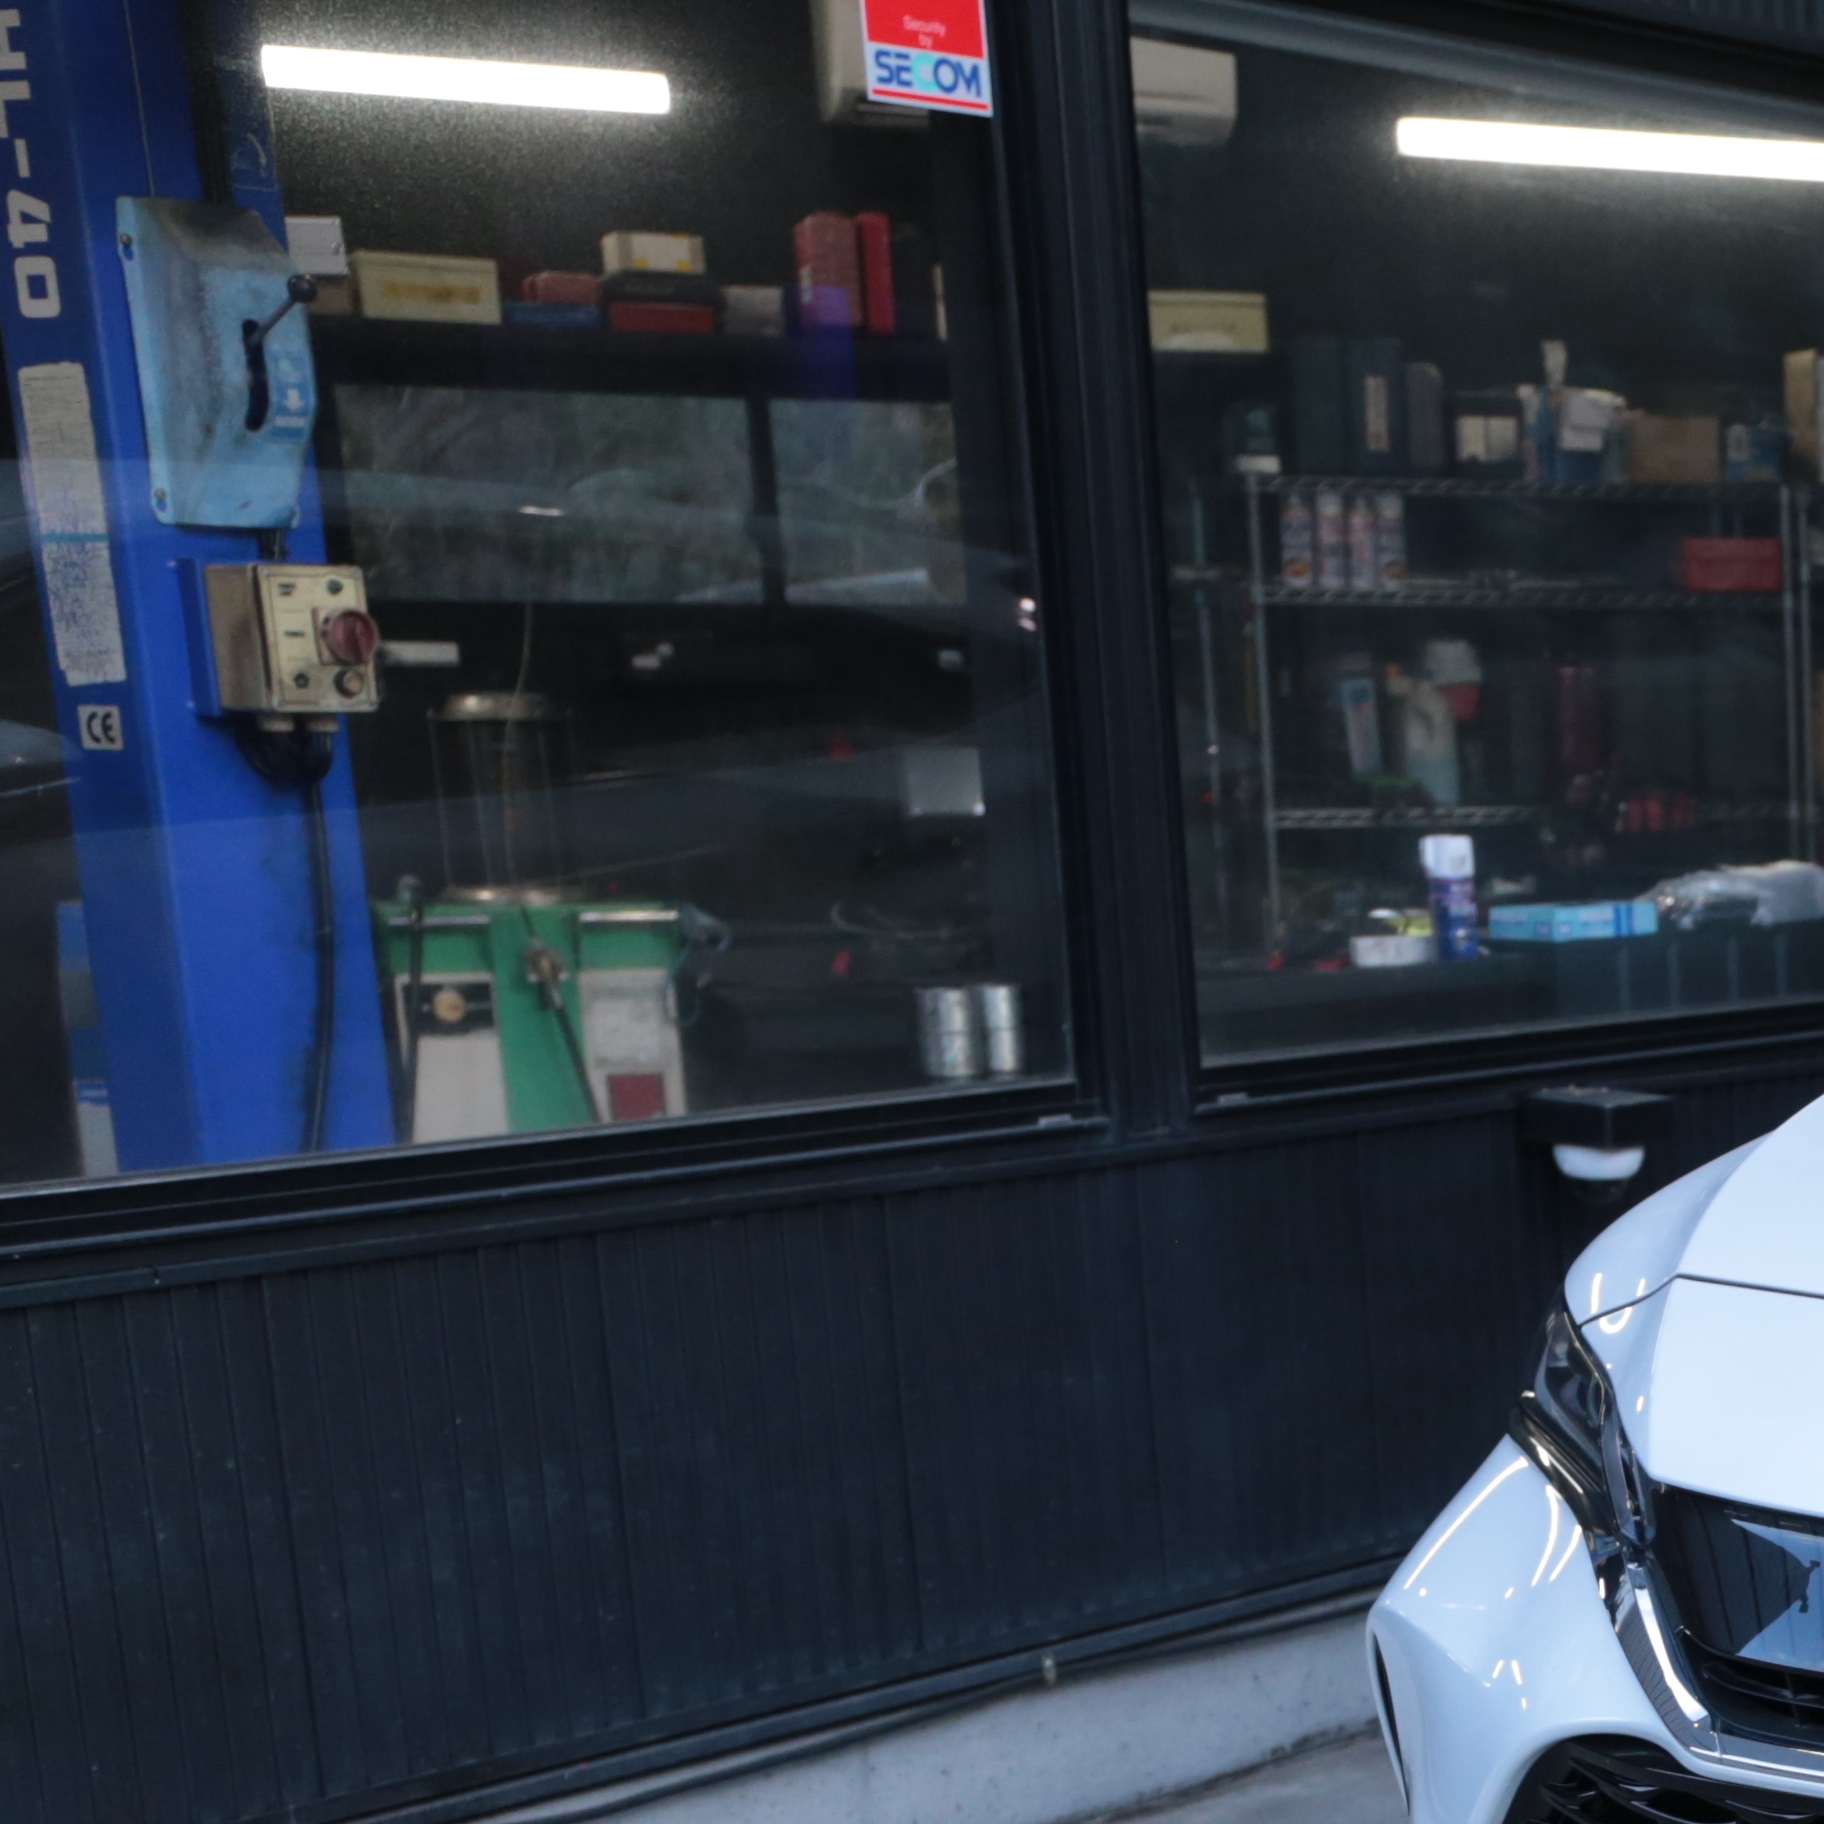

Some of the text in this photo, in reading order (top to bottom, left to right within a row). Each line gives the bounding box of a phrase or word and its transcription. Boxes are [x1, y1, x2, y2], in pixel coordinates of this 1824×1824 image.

[902, 15, 946, 37] Security
[919, 33, 933, 49] by
[874, 50, 982, 98] SECOM
[86, 711, 116, 744] CE
